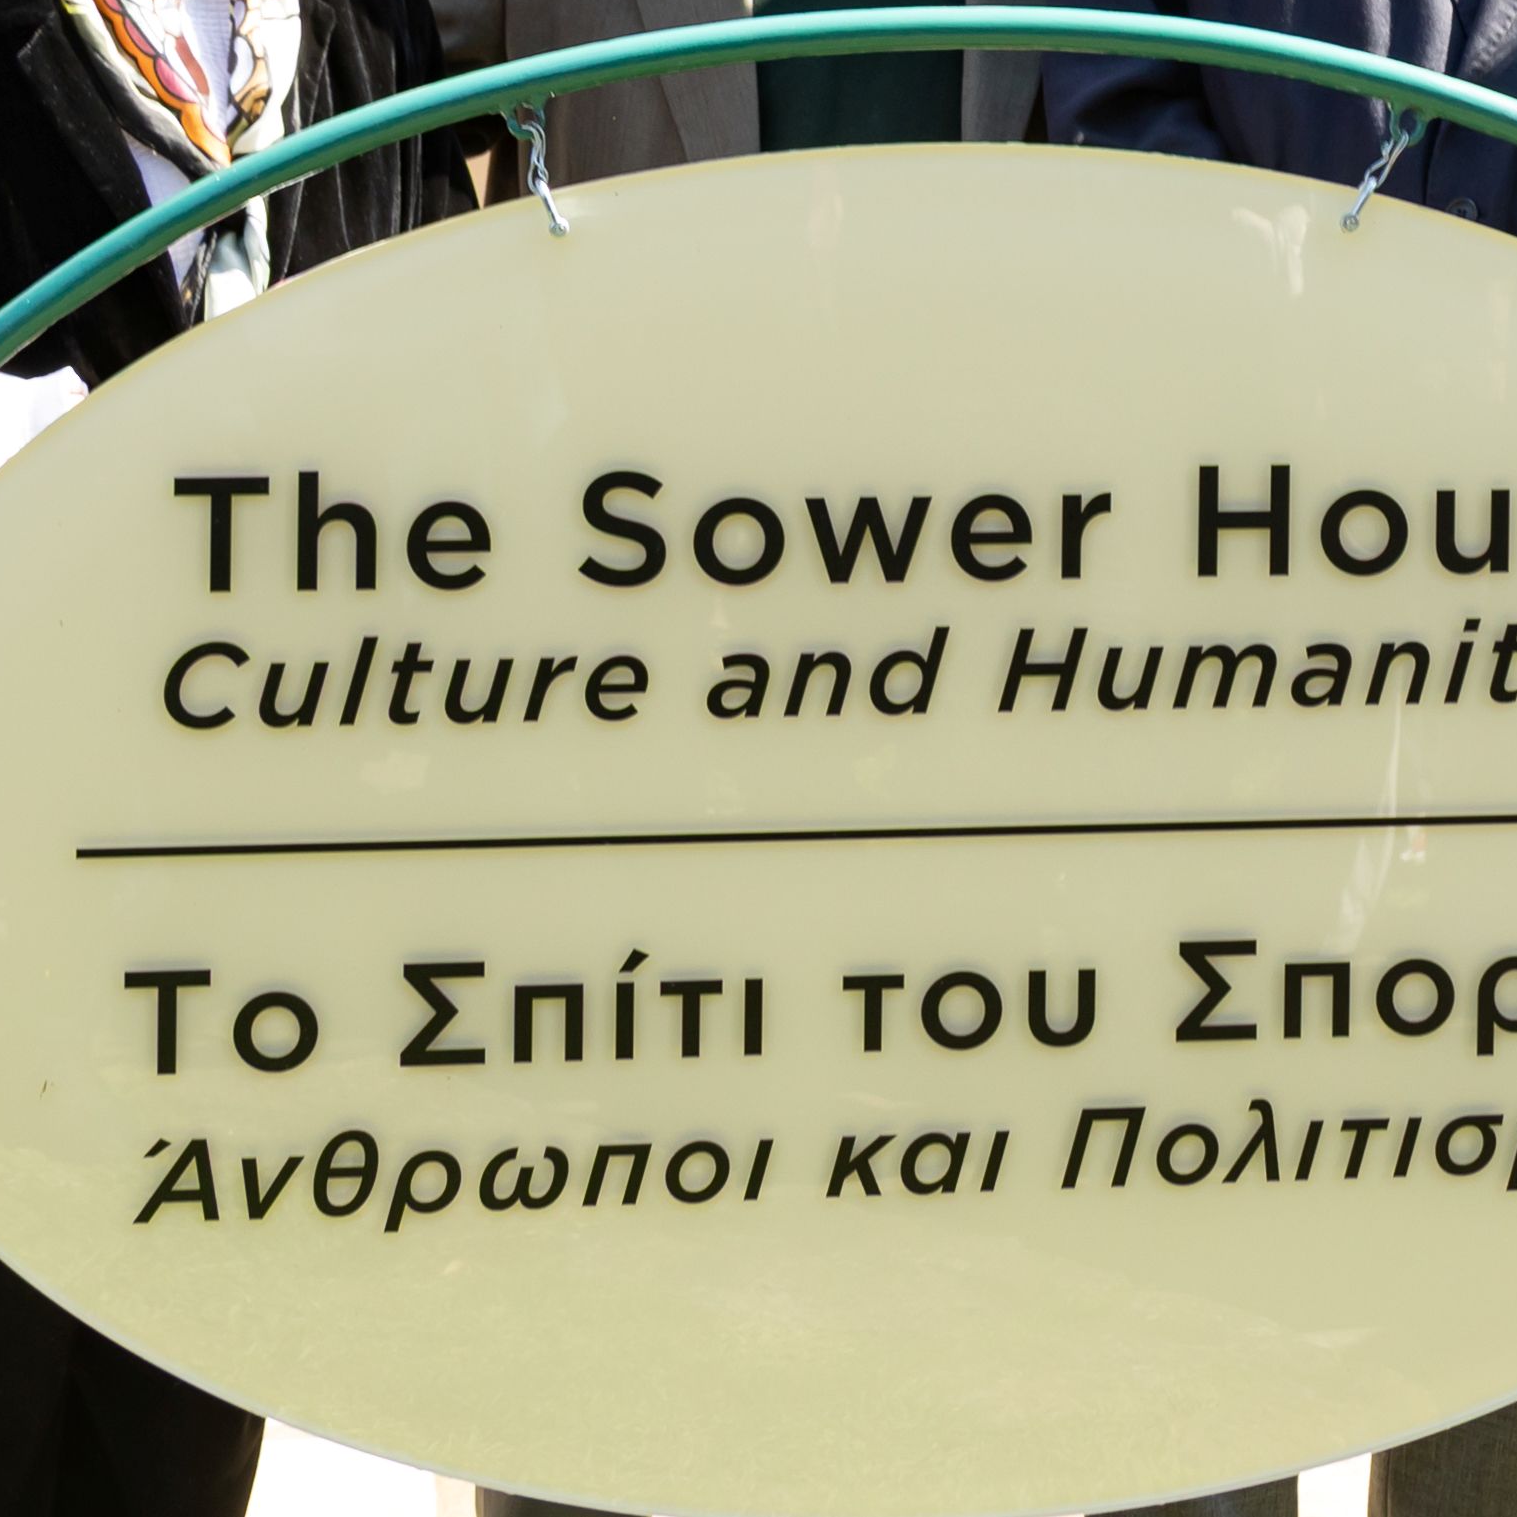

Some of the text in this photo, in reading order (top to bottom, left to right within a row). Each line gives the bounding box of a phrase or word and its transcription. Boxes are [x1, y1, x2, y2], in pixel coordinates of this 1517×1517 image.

[172, 469, 493, 594] The
[576, 469, 1113, 589] Sower
[162, 635, 650, 732] Culture
[705, 624, 951, 721] and
[122, 967, 320, 1076] Το
[398, 947, 765, 1068] Σπίτι
[841, 967, 1097, 1054] του
[132, 1128, 775, 1234] Άνθρωποι
[824, 1129, 1011, 1199] και
